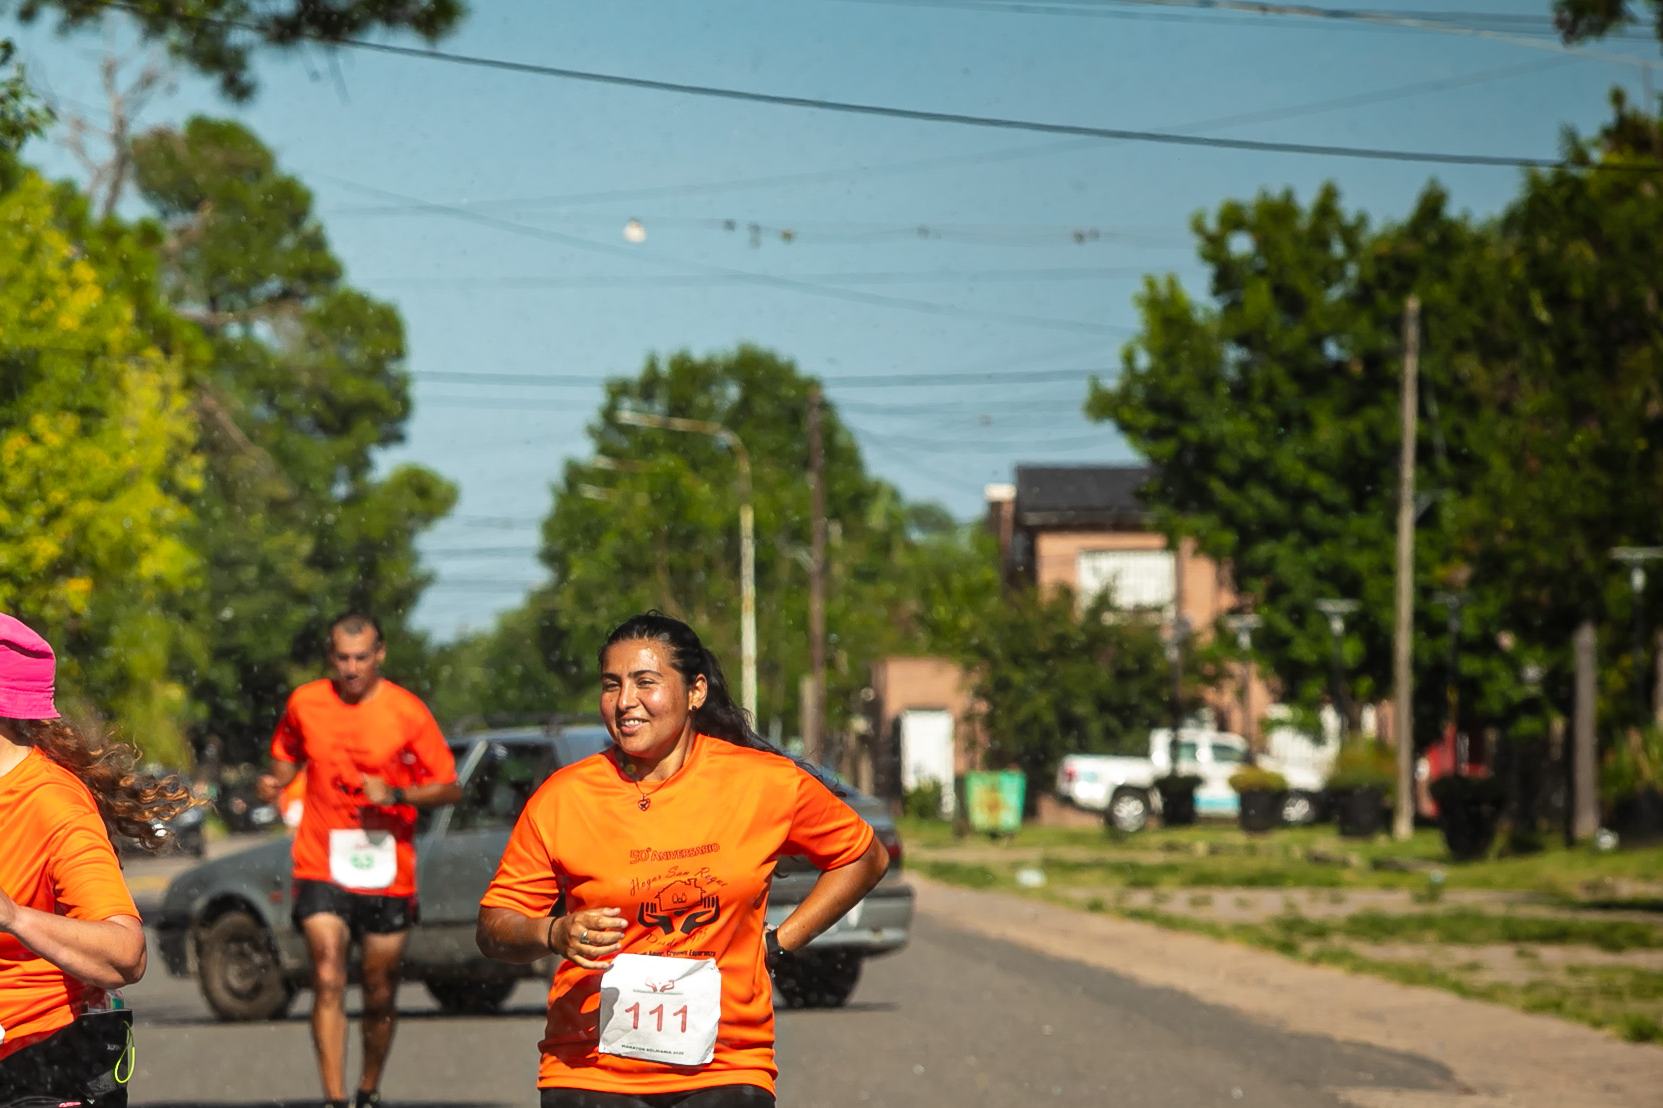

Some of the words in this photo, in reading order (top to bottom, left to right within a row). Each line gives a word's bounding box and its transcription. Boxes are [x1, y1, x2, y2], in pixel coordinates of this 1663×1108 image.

[650, 842, 721, 862] ANIVERSARIO
[630, 875, 661, 896] Hogar
[665, 865, 690, 879] San
[694, 866, 728, 887] Roque
[625, 1002, 687, 1033] 111
